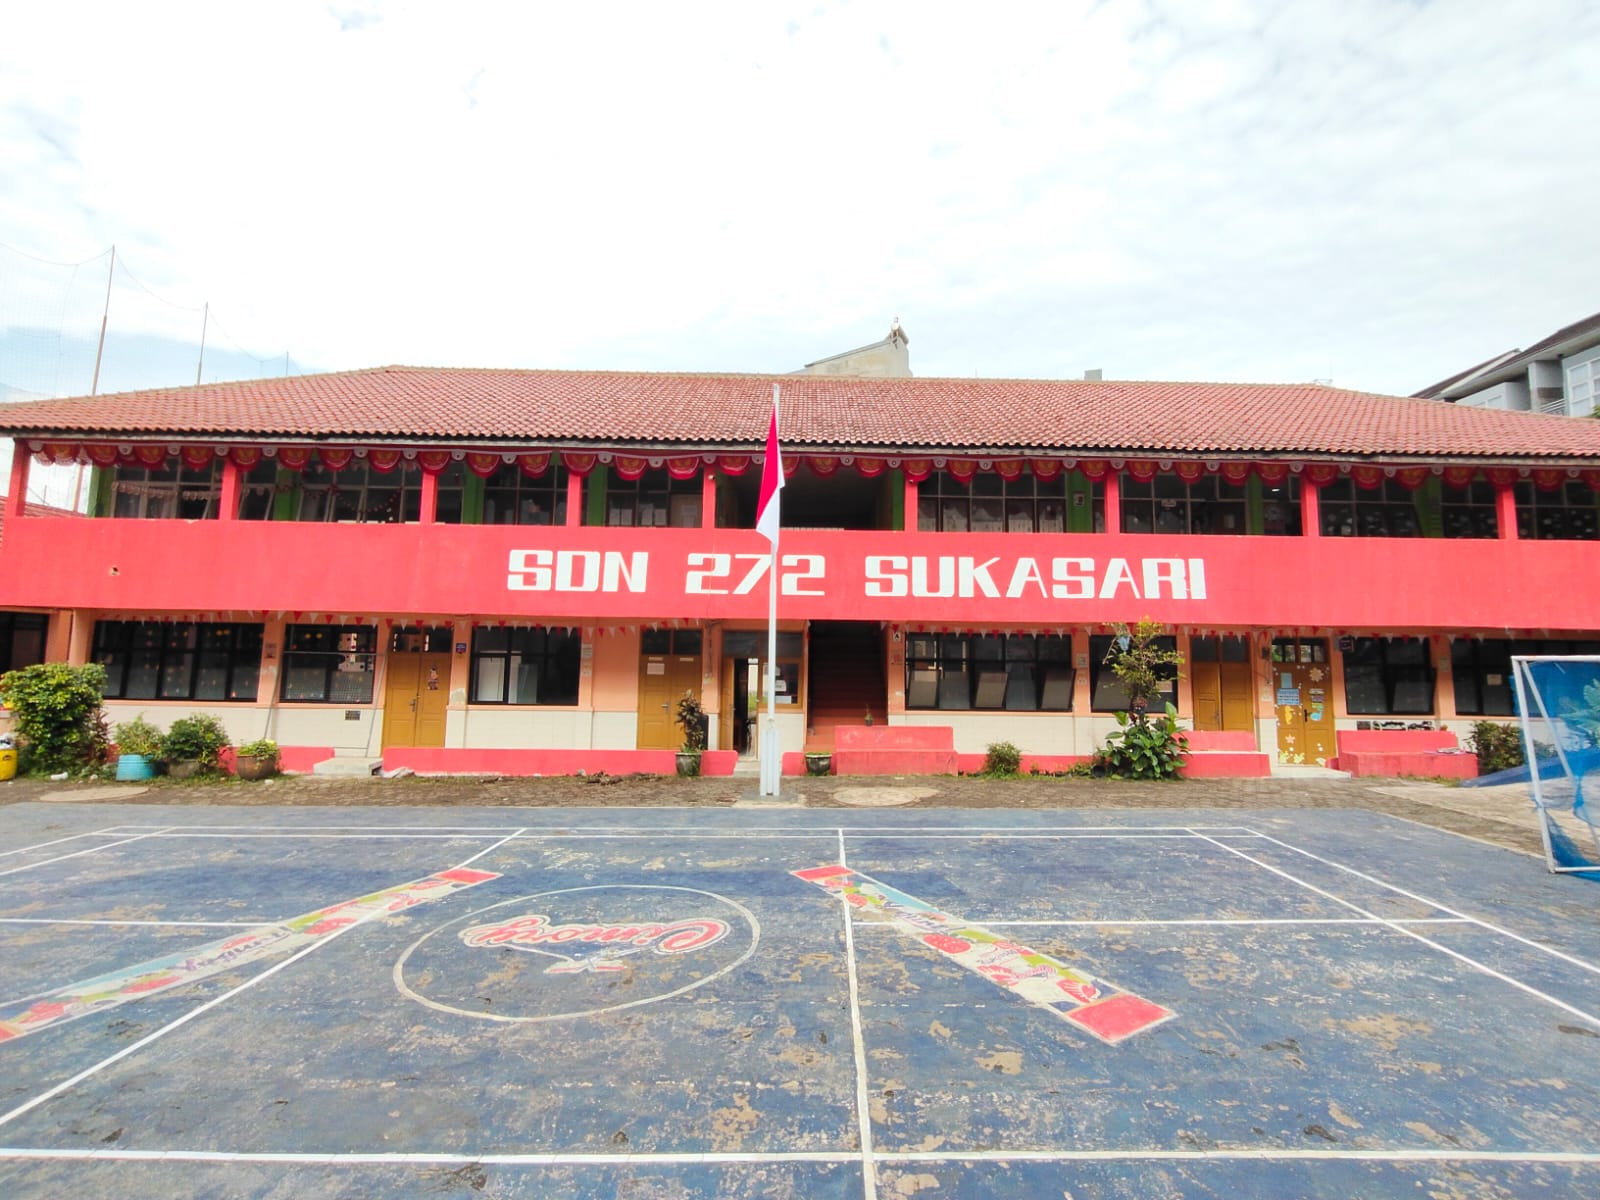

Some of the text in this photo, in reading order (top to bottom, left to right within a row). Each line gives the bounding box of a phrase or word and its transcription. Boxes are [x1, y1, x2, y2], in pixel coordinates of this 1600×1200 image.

[507, 549, 1207, 599] SDN 272 SUKASARI
[459, 915, 730, 953] Cimory
